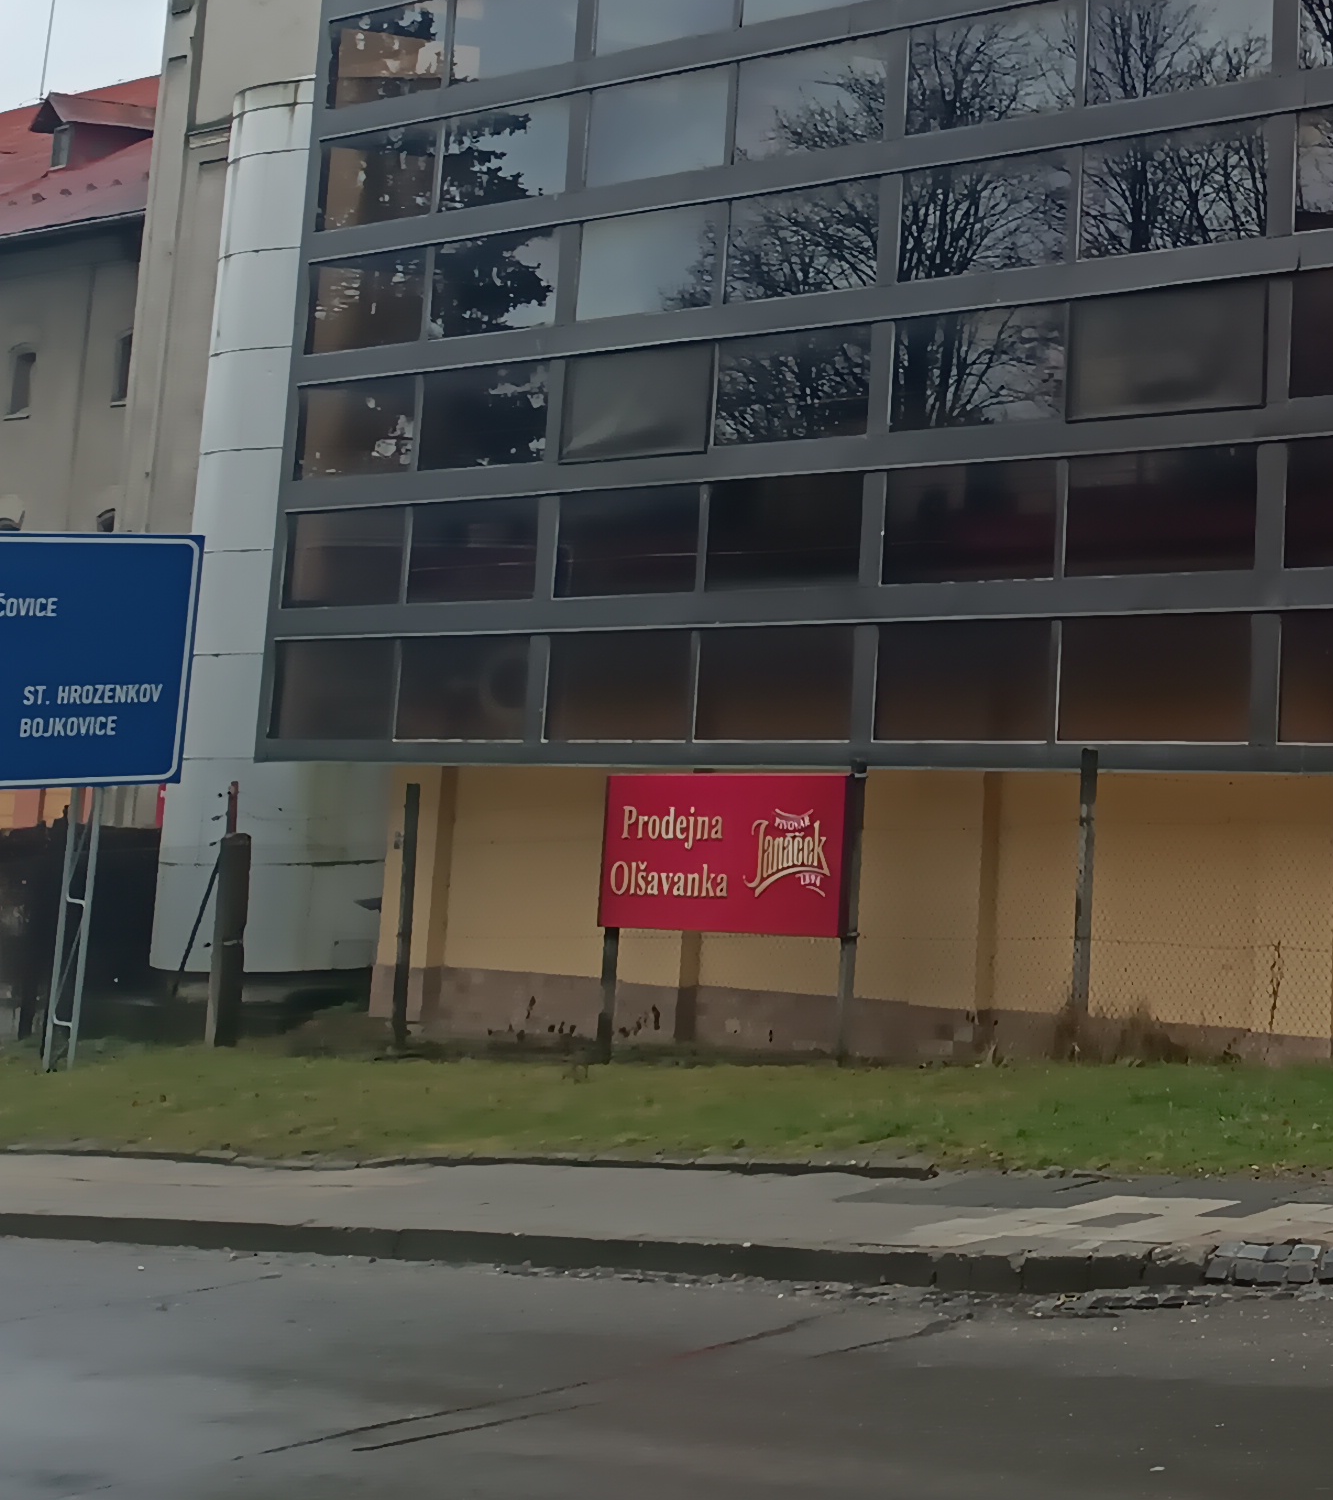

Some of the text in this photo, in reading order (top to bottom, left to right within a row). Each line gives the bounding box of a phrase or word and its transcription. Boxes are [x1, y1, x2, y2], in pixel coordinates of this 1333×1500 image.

[23, 683, 163, 705] ST. HROZENKOV
[19, 716, 118, 738] BOJKOVICE
[621, 805, 723, 850] Prodejna
[743, 819, 831, 888] Janáček
[610, 861, 728, 898] Olšavanka
